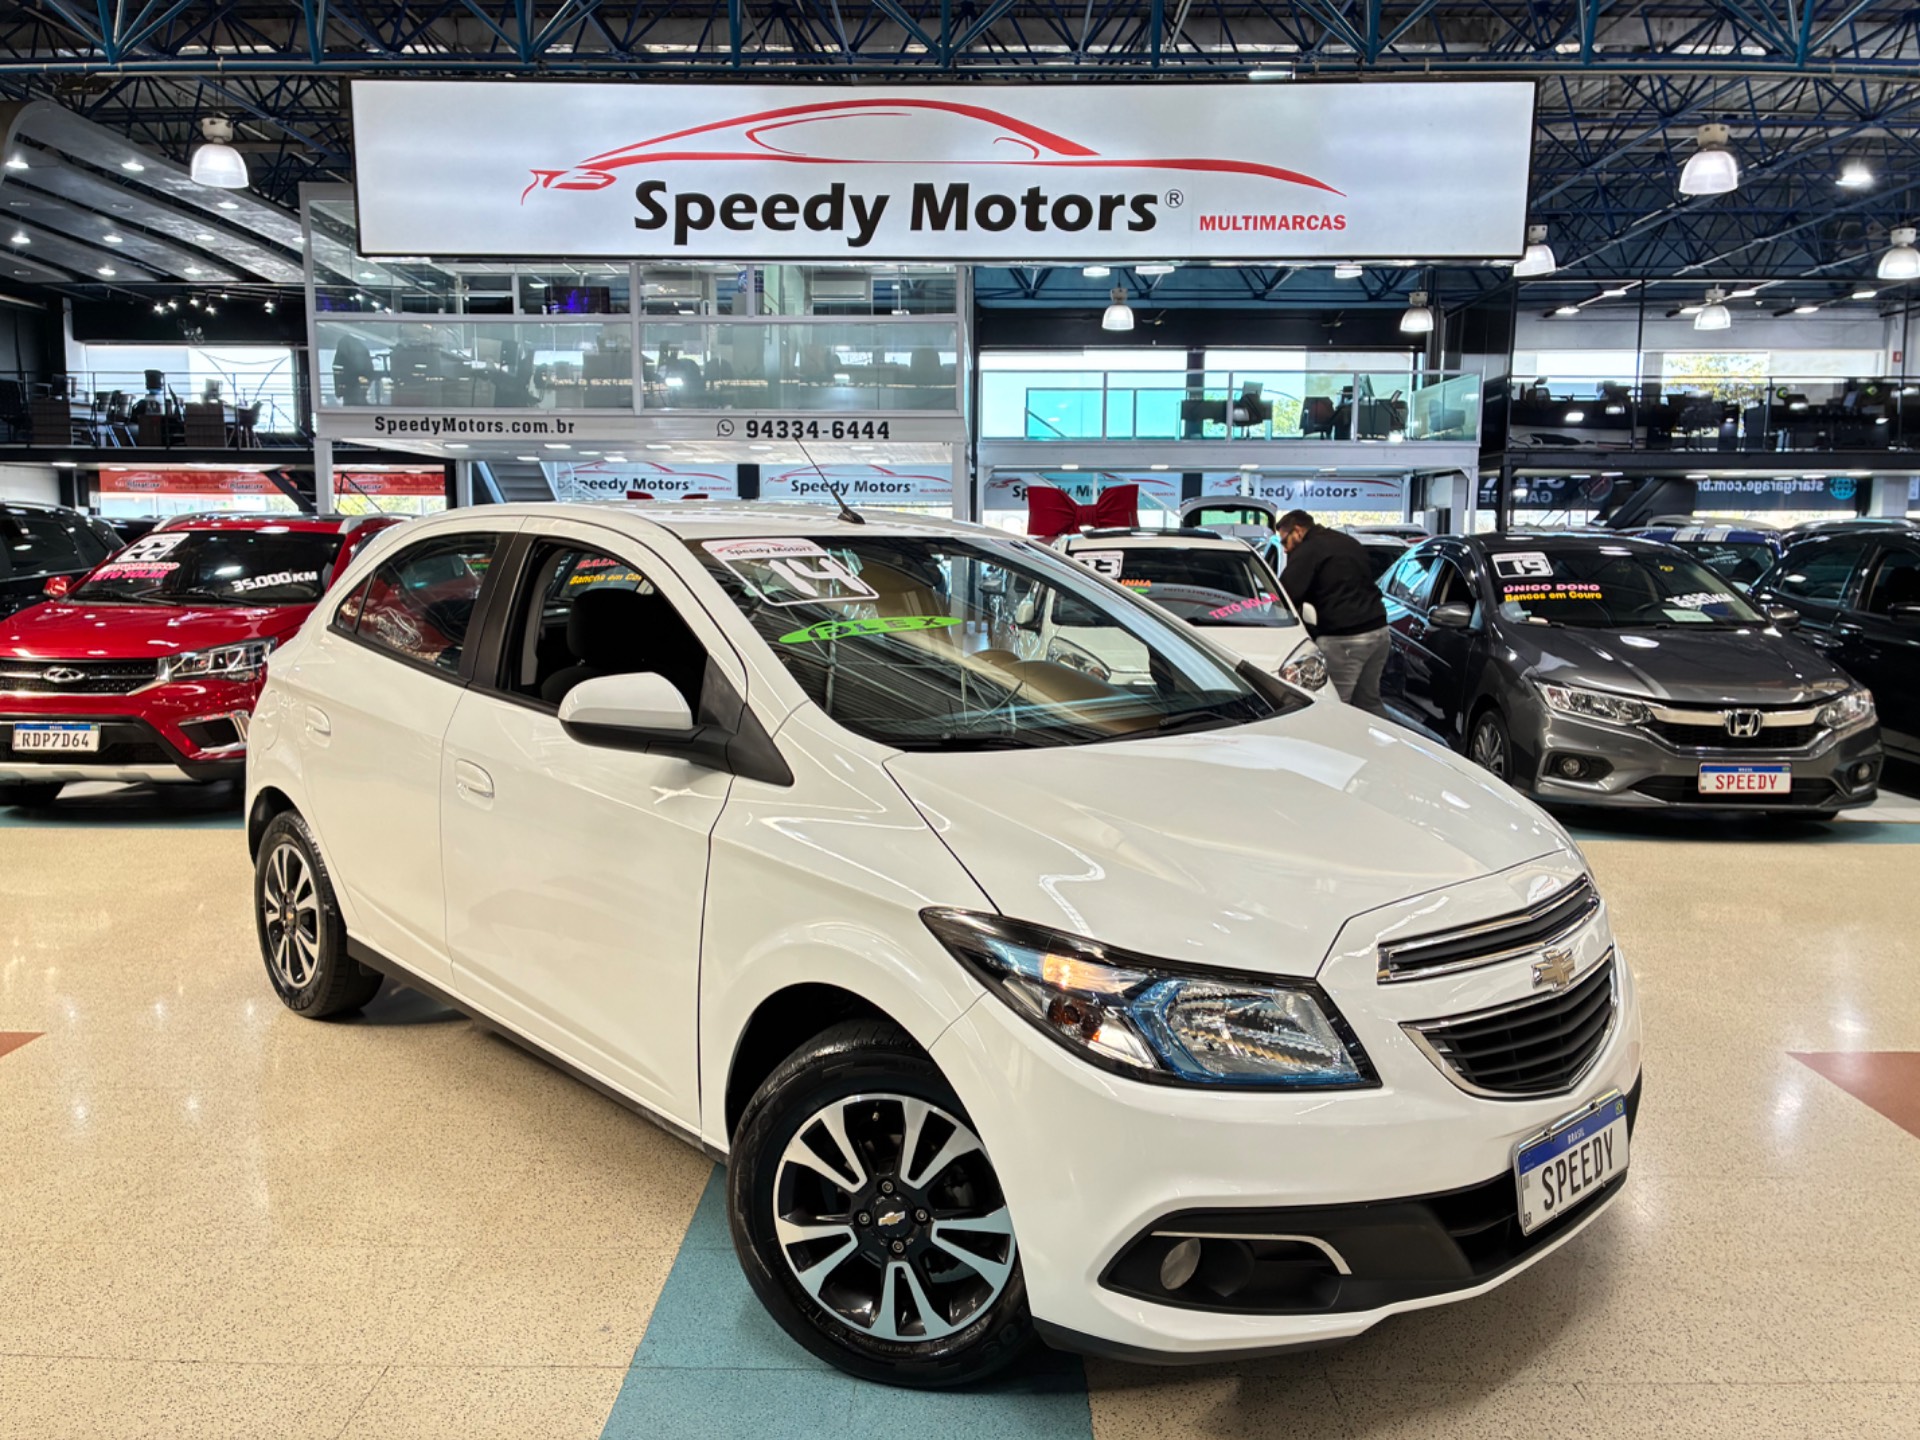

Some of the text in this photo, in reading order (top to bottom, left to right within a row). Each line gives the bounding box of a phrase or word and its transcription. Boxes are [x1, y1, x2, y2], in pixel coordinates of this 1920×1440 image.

[633, 180, 890, 248] Speedy
[1199, 215, 1347, 231] MULTIMARCAS
[374, 416, 575, 434] SpeedyMotors.com.br
[746, 420, 890, 440] 94334-6444
[768, 557, 870, 597] 14
[1556, 583, 1601, 591] DONO
[1209, 603, 1242, 620] TETO
[22, 732, 89, 747] RDP7D64
[1715, 774, 1777, 790] SPEEDY
[1567, 1128, 1585, 1144] BRASIL
[1542, 1127, 1613, 1210] SPEEDY
